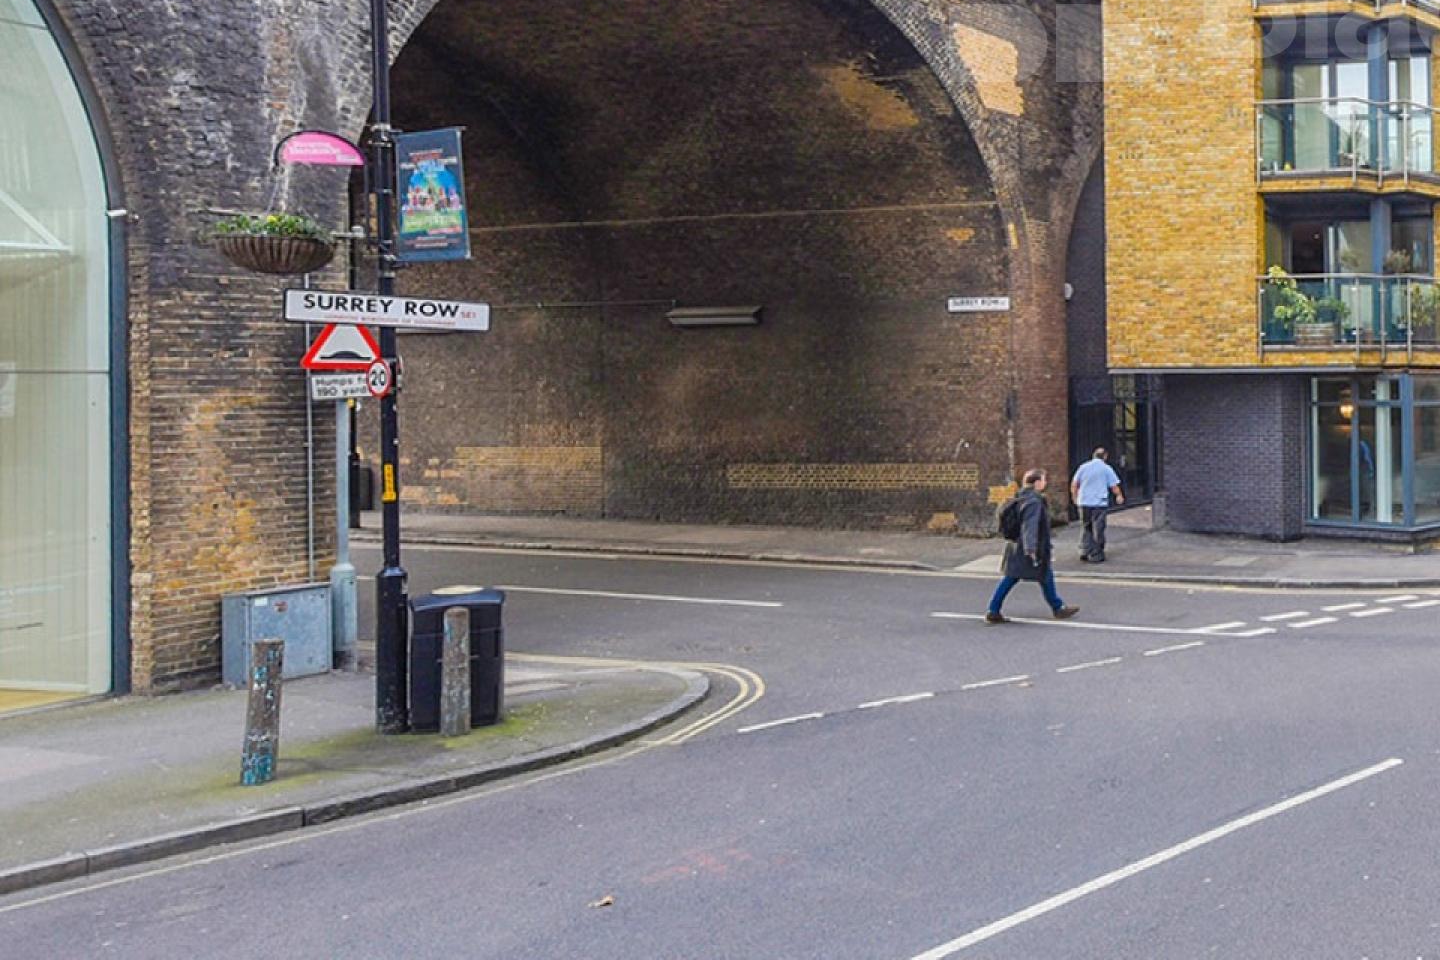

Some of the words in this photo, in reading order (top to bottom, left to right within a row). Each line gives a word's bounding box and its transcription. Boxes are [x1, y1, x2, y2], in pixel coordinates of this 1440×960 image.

[303, 293, 393, 313] SURREY
[404, 300, 460, 319] ROW
[371, 370, 386, 386] 20
[342, 386, 367, 398] yard
